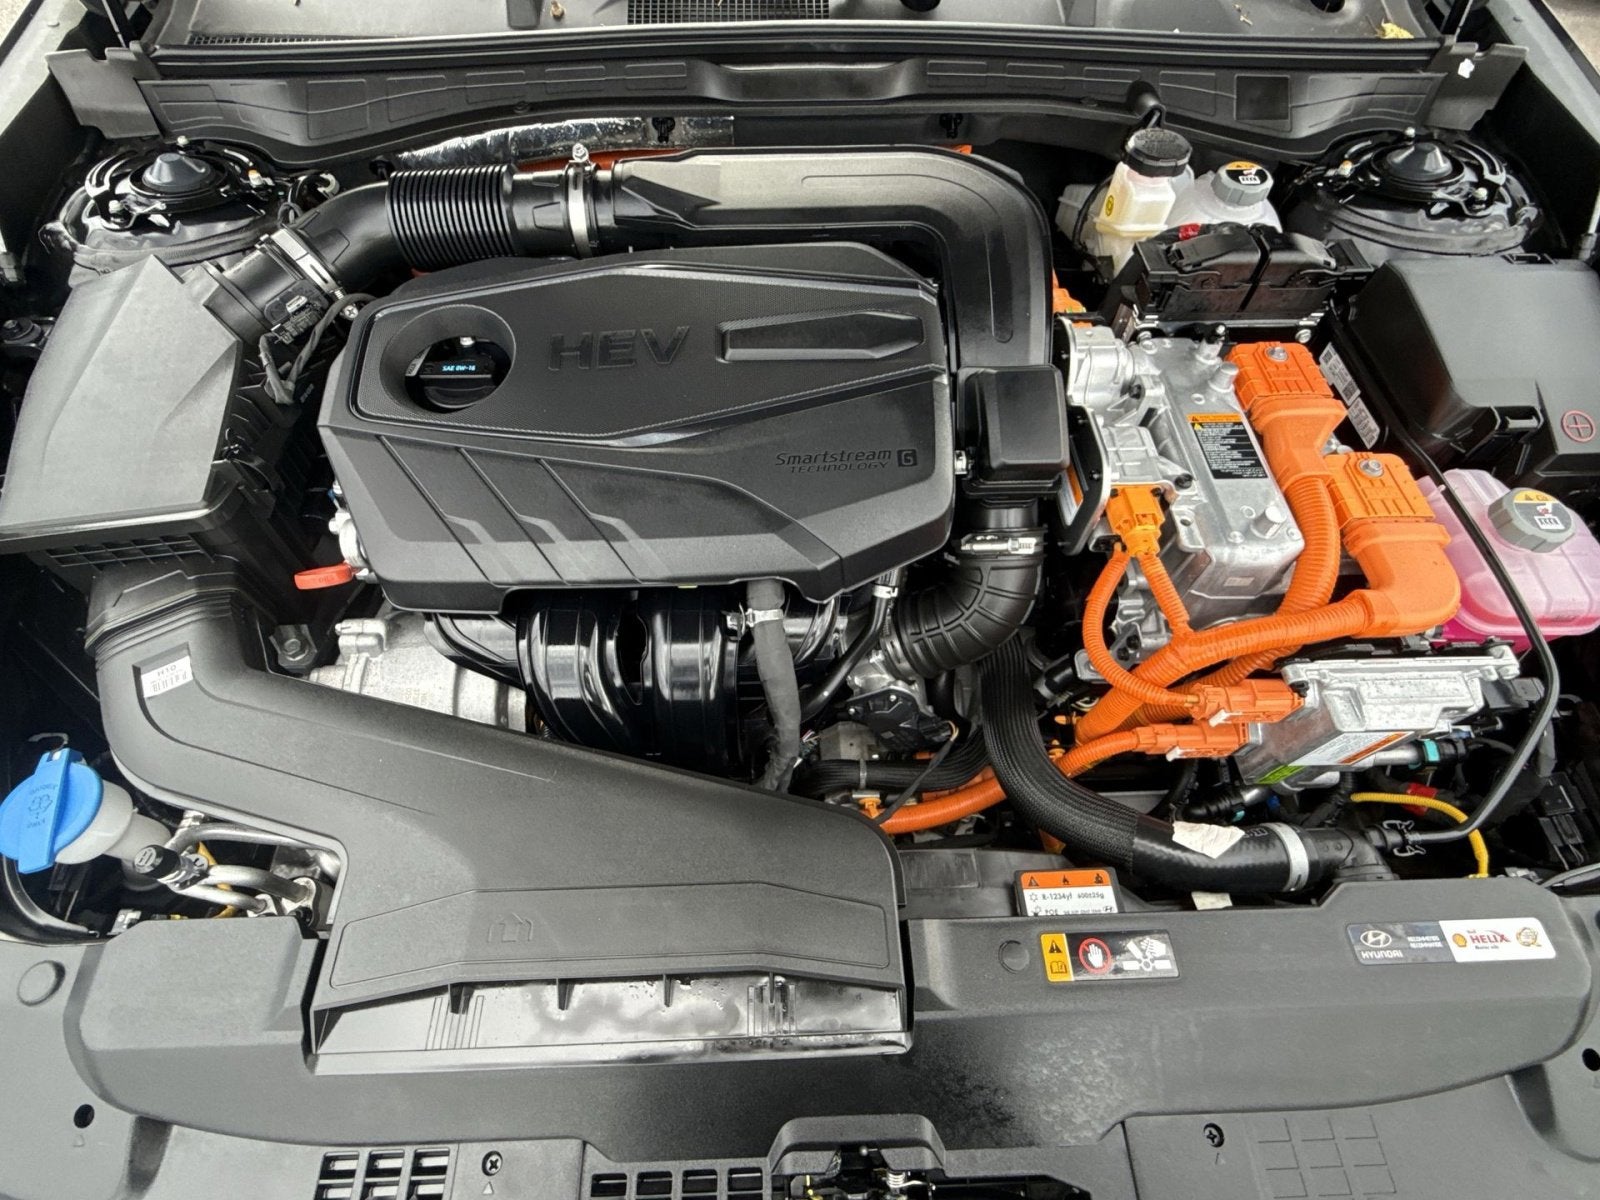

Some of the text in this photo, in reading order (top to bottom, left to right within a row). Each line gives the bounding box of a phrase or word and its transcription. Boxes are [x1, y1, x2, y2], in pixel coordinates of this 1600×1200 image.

[548, 326, 690, 371] HEV
[442, 364, 454, 372] SAE
[775, 450, 916, 467] Smartstream G
[790, 461, 889, 474] TECHNOLOGY
[1470, 933, 1511, 944] HELIX
[1361, 950, 1404, 959] HYUNDAI
